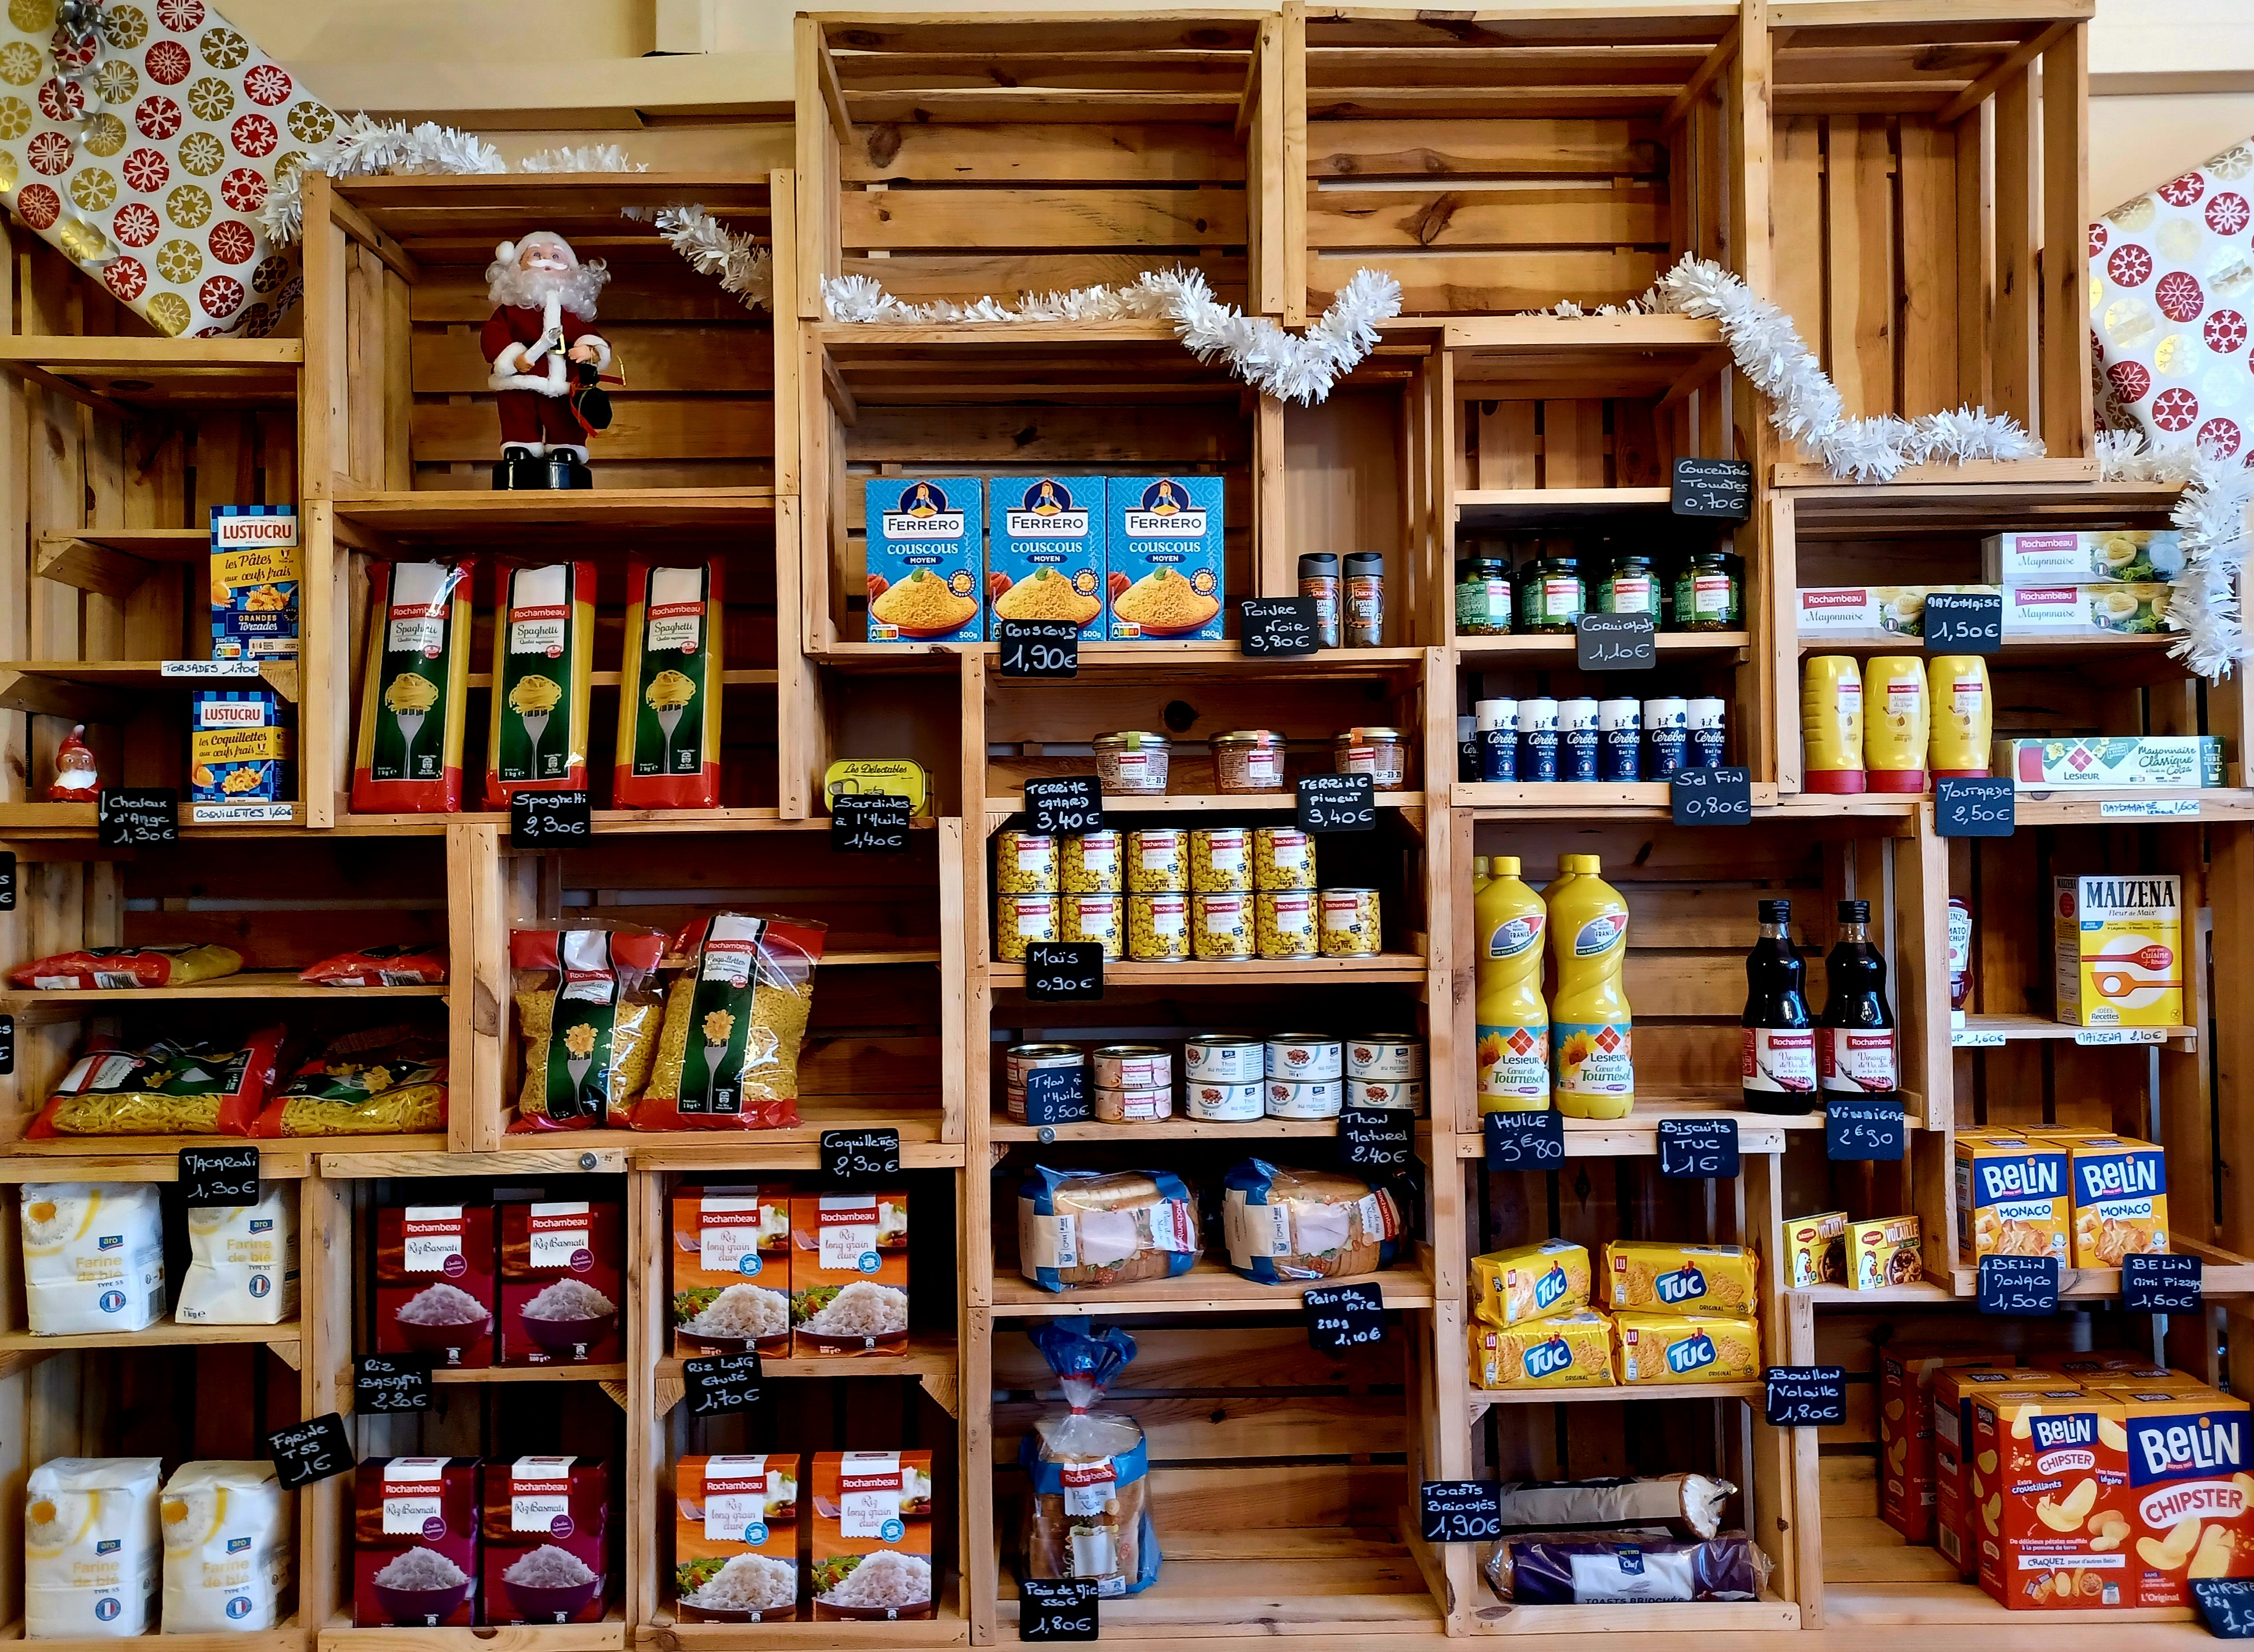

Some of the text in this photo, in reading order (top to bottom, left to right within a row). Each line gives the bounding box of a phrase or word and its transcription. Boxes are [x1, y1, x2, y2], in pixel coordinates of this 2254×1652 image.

[1680, 479, 1748, 493] Tomates
[1685, 493, 1743, 511] 0,70€
[889, 518, 959, 531] FERRERO
[1012, 517, 1083, 529] FERRERO
[1130, 517, 1201, 529] FERRERO
[223, 524, 291, 539] LUSTUCRU
[2021, 540, 2073, 550] Rochambeau
[226, 553, 271, 569] les Pâtes
[2019, 556, 2074, 567] Mayonnaise
[267, 567, 291, 581] frais
[2020, 592, 2072, 602] Rochambeau
[1806, 611, 1863, 623] Mayonnaise
[239, 621, 278, 631] Torsades
[518, 625, 559, 637] Spaghetti
[1006, 623, 1077, 639] Couscous
[1932, 622, 1998, 642] 1,50€
[1083, 630, 1101, 639] 500g
[1251, 635, 1309, 651] 3,80€
[1003, 644, 1077, 671] 1,90€
[1589, 643, 1650, 661] 1,10€
[163, 664, 219, 673] TORSADES
[205, 708, 260, 721] LUSTUCRU
[199, 732, 267, 747] les Coquillettes
[2138, 747, 2196, 759] Mayonnaise
[843, 764, 859, 773] Les
[2139, 756, 2194, 771] Classique
[2167, 765, 2191, 776] Colza
[1676, 772, 1706, 786] Sel
[513, 794, 586, 809] Spaghetti
[835, 797, 909, 808] Sardines
[1686, 797, 1748, 818] 0,80€
[114, 813, 169, 827] d'Ange
[1037, 812, 1099, 830] 3,40€
[1308, 809, 1374, 827] 3,40€
[1953, 807, 2009, 823] 2,50€
[523, 816, 585, 836] 2,30€
[114, 828, 174, 844] 1,30€
[844, 832, 902, 848] 1,40€
[2087, 880, 2176, 909] MAIZENA
[1034, 948, 1078, 966] Maïs
[1037, 977, 1096, 991] 0,90€
[1779, 1052, 1808, 1064] Vinaigre
[1493, 1071, 1545, 1084] Tournesol
[1581, 1069, 1631, 1081] Tournesol
[1044, 1105, 1089, 1122] 2,50€
[1661, 1122, 1731, 1135] Biscuits
[824, 1133, 898, 1154] Coquillettes
[1351, 1146, 1407, 1163] 2,40€
[833, 1156, 898, 1177] 2,30€
[1673, 1156, 1718, 1173] 1€
[188, 1181, 255, 1198] 1,30€
[1999, 1205, 2051, 1217] MONACO
[2101, 1205, 2151, 1217] MONACO
[532, 1217, 588, 1228] Rochambeau
[839, 1228, 855, 1241] Riz
[1886, 1223, 1918, 1243] VOLAILLE
[227, 1238, 271, 1250] Farine
[408, 1242, 458, 1255] Riz Basmati
[707, 1241, 750, 1254] long grain
[76, 1256, 122, 1267] Farine
[228, 1252, 271, 1262] de blé
[1538, 1277, 1565, 1306] TUC
[1660, 1275, 1701, 1298] TUC
[1305, 1289, 1365, 1305] Pain de
[1990, 1295, 2053, 1310] 1,50€
[1346, 1301, 1380, 1311] mie
[1699, 1304, 1724, 1312] ORIGINAL
[1335, 1327, 1380, 1346] 1,10€
[1527, 1346, 1568, 1374] TUC
[1670, 1342, 1712, 1369] TUC
[688, 1361, 714, 1373] Riz
[1770, 1370, 1840, 1381] Bouillon
[1777, 1386, 1838, 1399] Volaille
[372, 1393, 427, 1409] 2,20€
[696, 1389, 760, 1413] 1,70€
[1776, 1404, 1838, 1421] 1,80€
[2041, 1453, 2092, 1472] CHIPSTER
[2012, 1481, 2062, 1494] croustillants
[2101, 1476, 2122, 1485] légère
[2145, 1489, 2242, 1522] CHIPSTER
[1429, 1514, 1500, 1540] 1,90€
[202, 1559, 249, 1574] Farine
[2028, 1558, 2065, 1567] CRAQUEZ
[1057, 1584, 1074, 1595] de
[2141, 1593, 2180, 1603] L'Original
[1029, 1617, 1090, 1634] 1,80€
